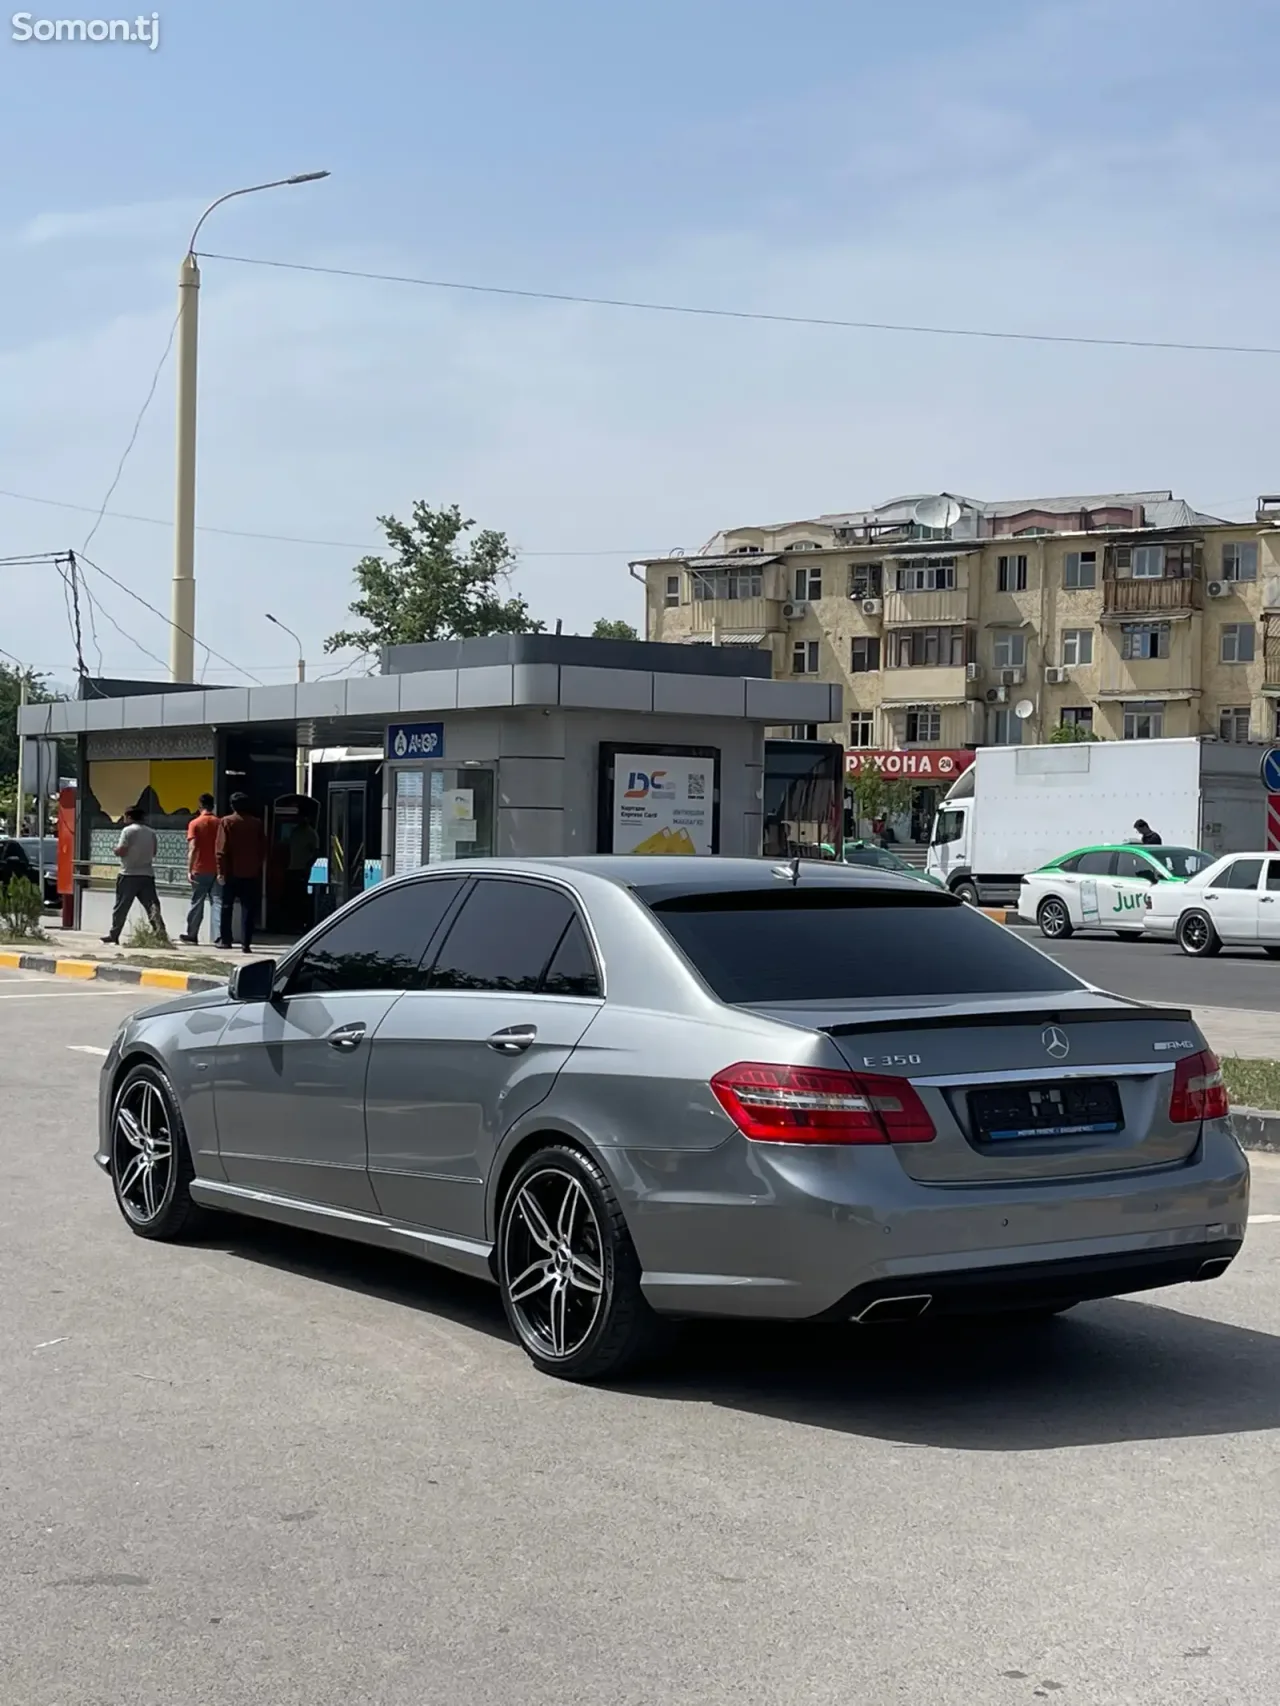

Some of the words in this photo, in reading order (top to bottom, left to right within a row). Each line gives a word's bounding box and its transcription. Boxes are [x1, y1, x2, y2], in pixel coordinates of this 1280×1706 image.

[1167, 1040, 1194, 1049] AMG
[863, 1056, 876, 1067] E
[881, 1054, 921, 1066] 350
